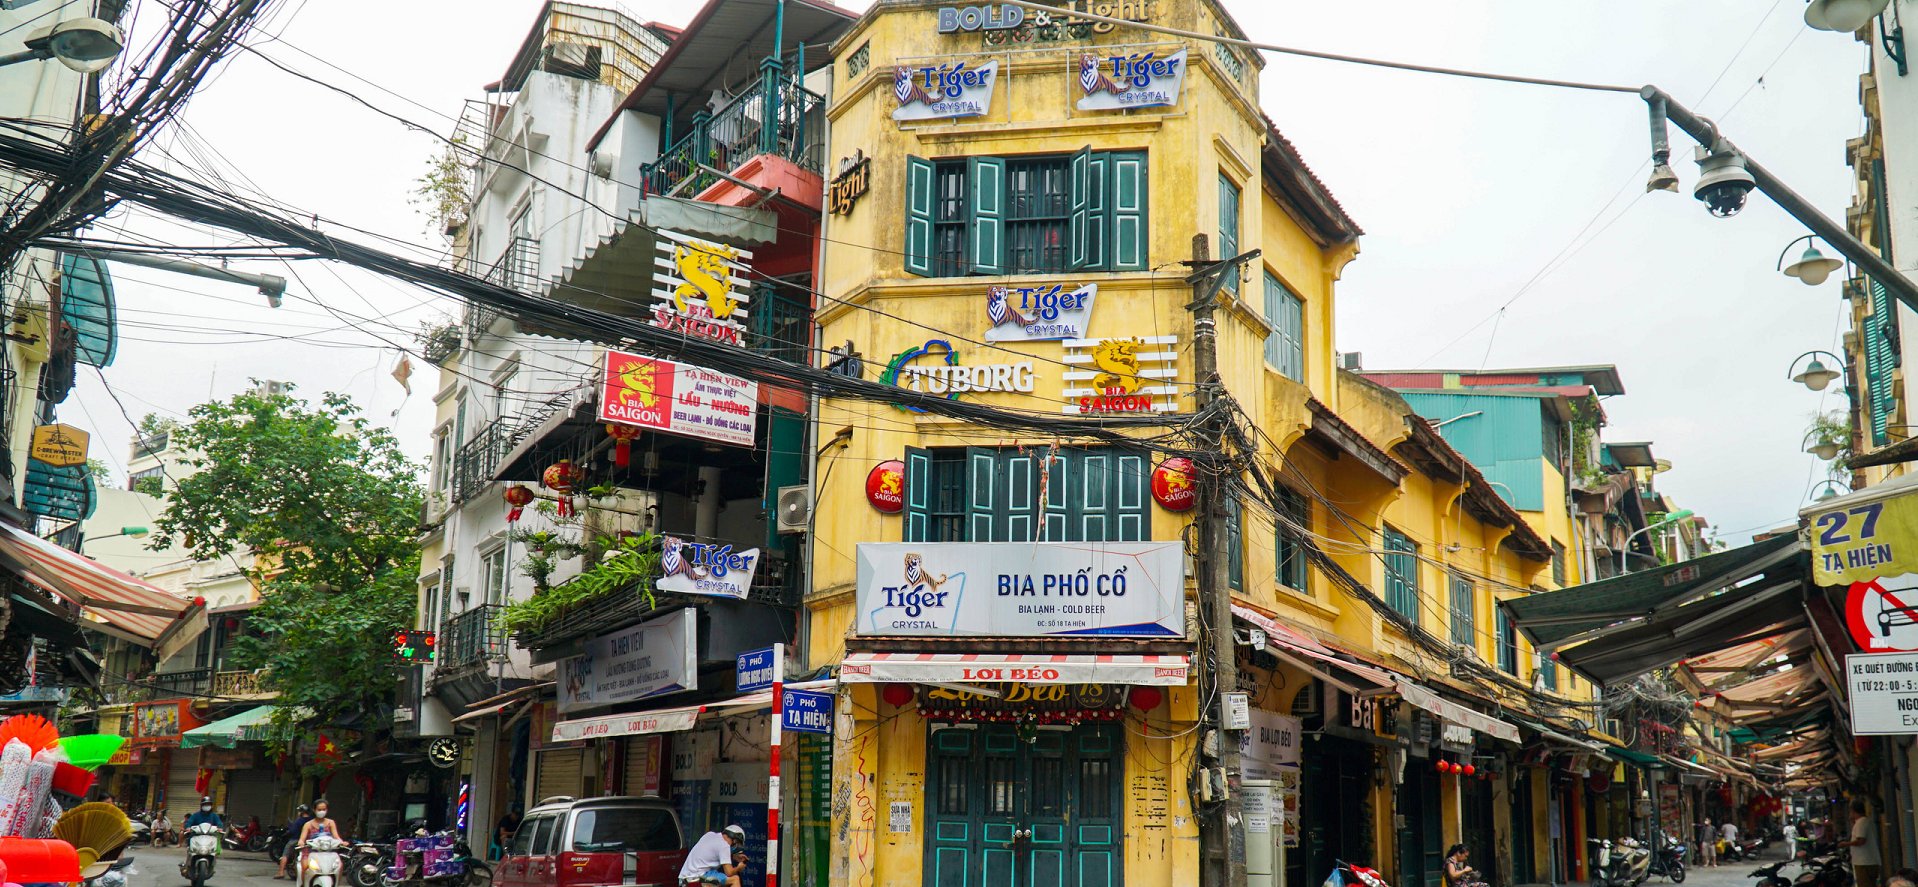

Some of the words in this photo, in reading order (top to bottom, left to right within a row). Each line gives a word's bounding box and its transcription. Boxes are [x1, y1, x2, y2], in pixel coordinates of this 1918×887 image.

[938, 5, 1025, 33] BOLD
[1035, 10, 1050, 26] &
[1108, 52, 1180, 88] Tiger
[919, 62, 991, 98] Tiger
[1118, 91, 1170, 102] CRYSTAL
[931, 101, 981, 113] CRYSTAL
[1016, 284, 1089, 321] Tiger
[688, 303, 714, 320] BIA
[1025, 325, 1078, 335] CRYSTAL
[905, 361, 1035, 393] TUBORG
[1105, 385, 1127, 397] BIA
[627, 399, 645, 410] BIA
[1079, 395, 1154, 414] SAIGON
[607, 403, 661, 424] SAIGON
[673, 410, 687, 421] BEER
[874, 492, 902, 503] SAIGON
[1816, 502, 1884, 547] 27
[690, 543, 755, 578] Tiger
[1822, 551, 1845, 575] TẠ
[1847, 542, 1893, 569] HIỆN
[696, 579, 743, 593] CRYSTAL
[997, 574, 1036, 597] BIA
[1043, 566, 1092, 597] PHỐ
[1096, 565, 1128, 597] CỔ
[881, 584, 949, 617] Tiger
[1018, 605, 1032, 614] BIA
[1034, 605, 1055, 616] LẠNH
[1062, 605, 1083, 614] COLD
[1085, 605, 1106, 614] BEER
[891, 620, 938, 629] CRYSTAL
[749, 653, 763, 667] PHỐ
[1853, 664, 1863, 674] XE
[1866, 661, 1884, 674] QUÉT
[1887, 659, 1913, 673] ĐƯỜNG
[1010, 665, 1060, 680] BÉO
[1874, 680, 1900, 691] 22:00
[799, 697, 817, 708] PHỐ
[788, 709, 801, 727] TẠ
[803, 709, 827, 729] HIỆN
[1260, 726, 1270, 745] BIA
[675, 752, 693, 770] BOLD
[719, 781, 738, 797] BOLD
